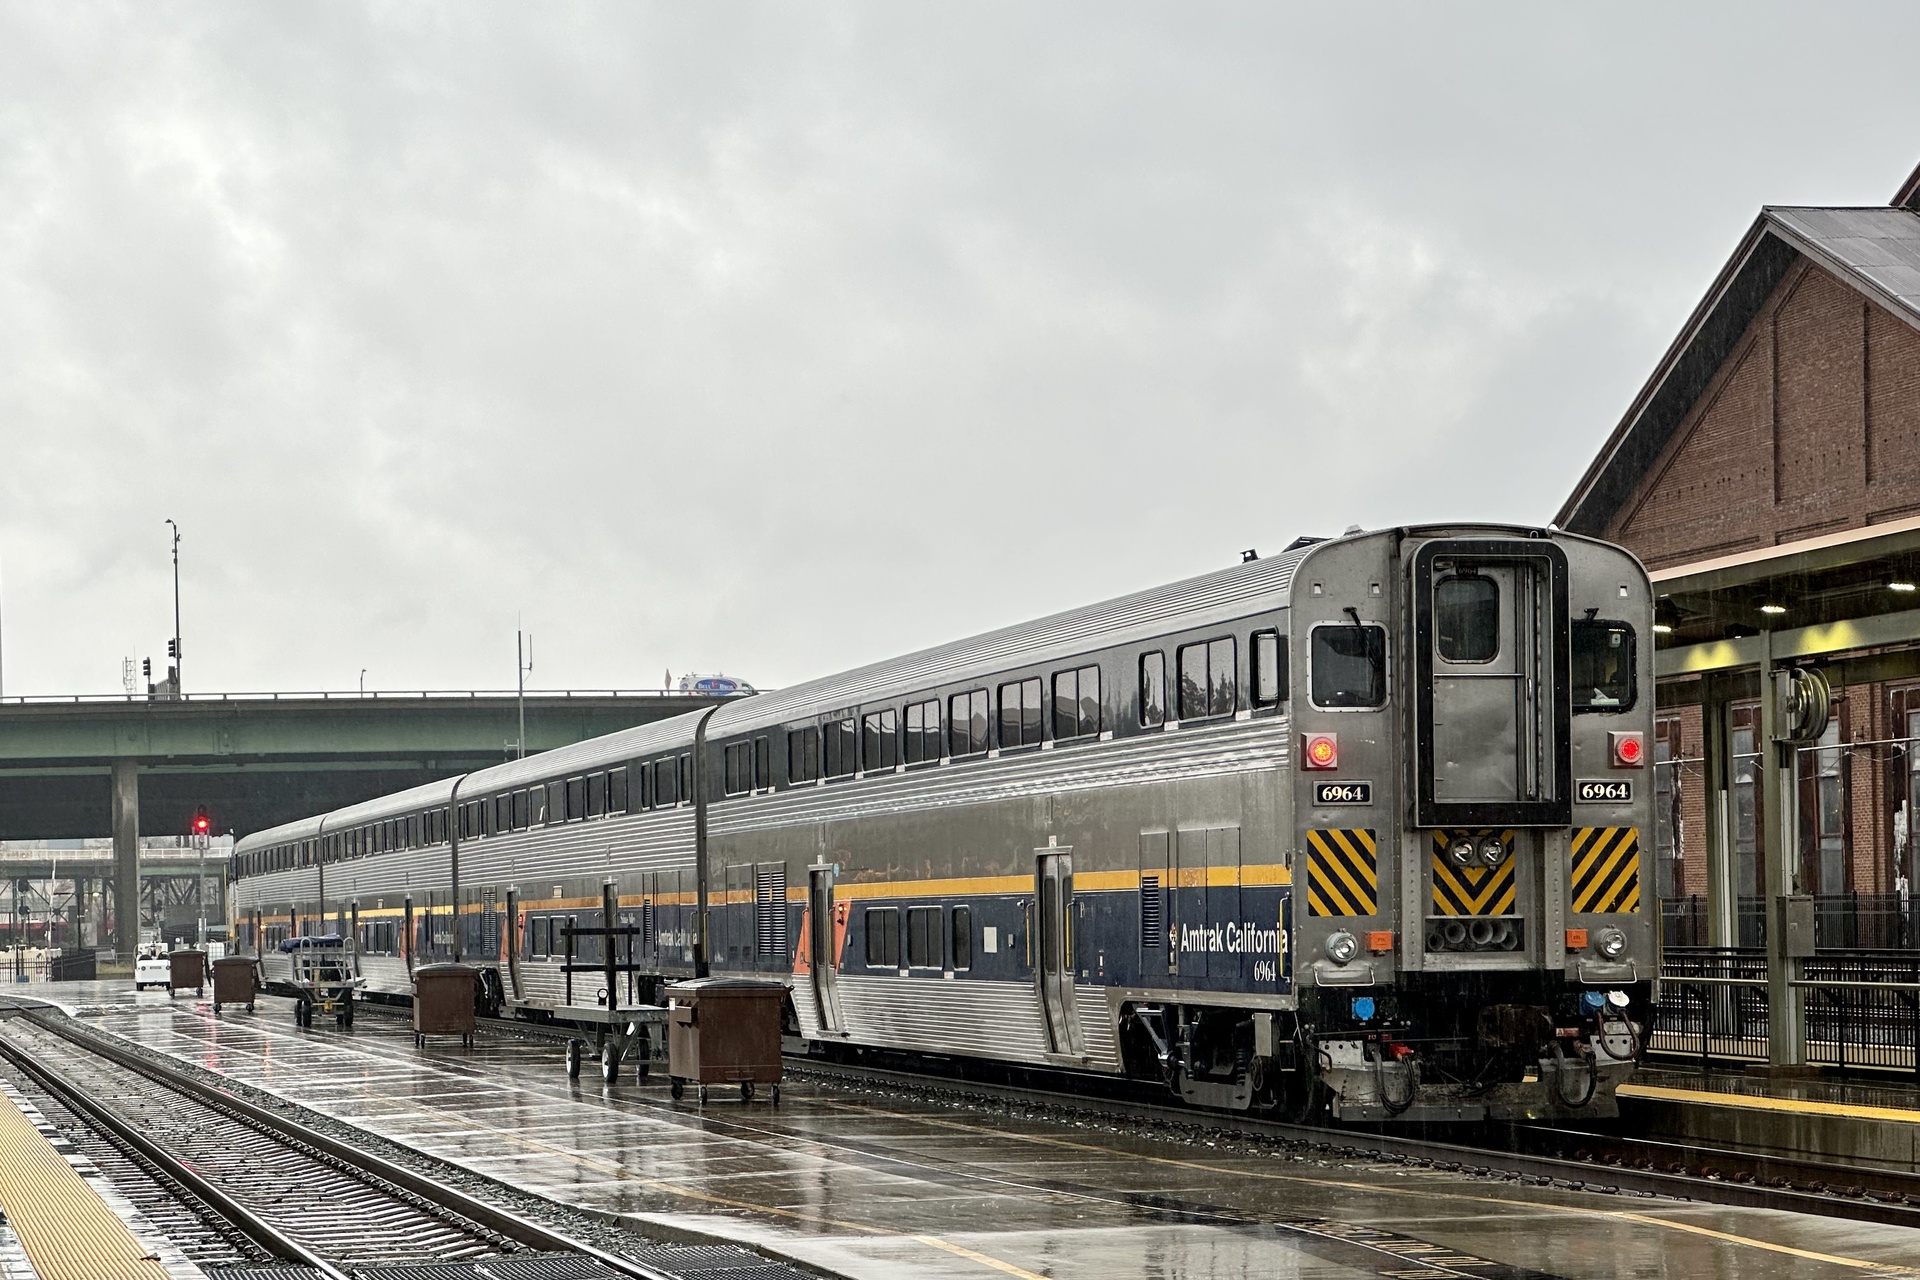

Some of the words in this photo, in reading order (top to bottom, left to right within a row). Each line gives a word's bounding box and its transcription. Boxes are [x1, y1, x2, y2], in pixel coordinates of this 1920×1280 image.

[1322, 786, 1364, 801] 6964
[1582, 783, 1628, 799] 6964
[1180, 921, 1224, 953] Amtrak
[1226, 921, 1288, 954] California
[1254, 960, 1276, 982] 6964
